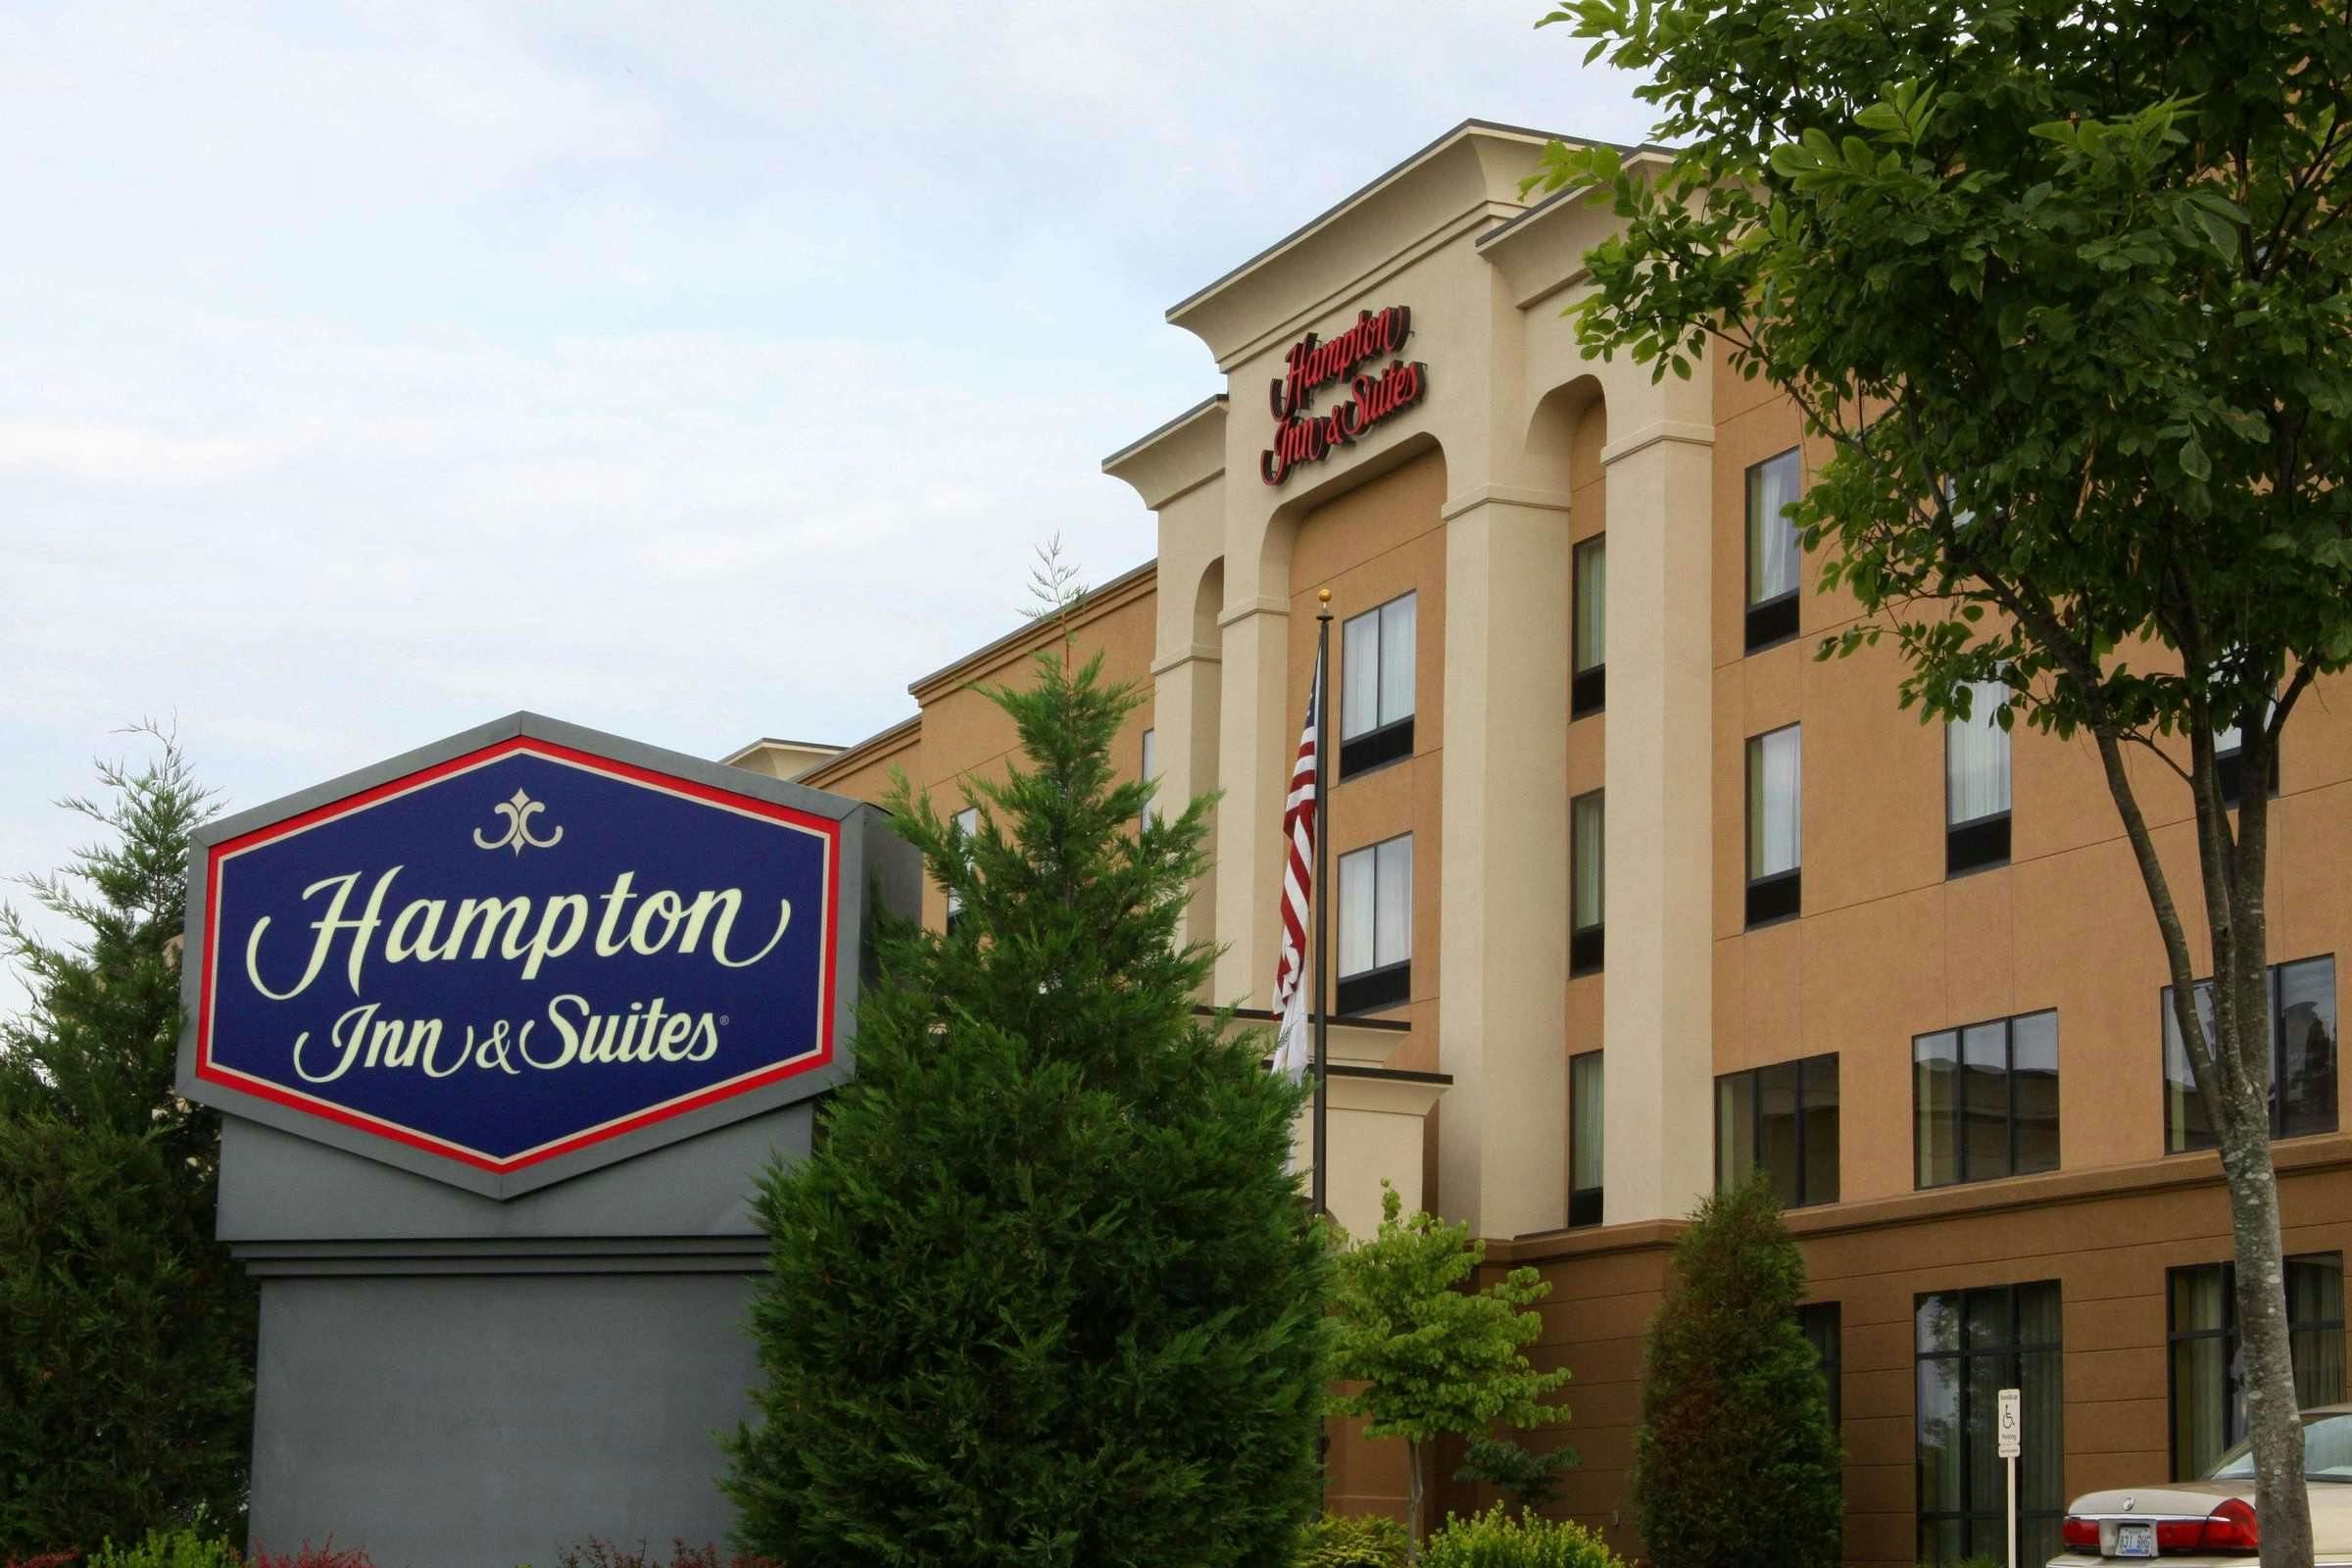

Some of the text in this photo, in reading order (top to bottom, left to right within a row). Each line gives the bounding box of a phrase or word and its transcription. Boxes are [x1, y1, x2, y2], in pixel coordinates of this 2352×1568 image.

[1260, 360, 1427, 486] Inn & Suites
[1270, 305, 1411, 422] Hampton
[246, 865, 791, 1000] Hampton
[293, 1003, 474, 1083] Inn
[475, 1019, 520, 1074] &
